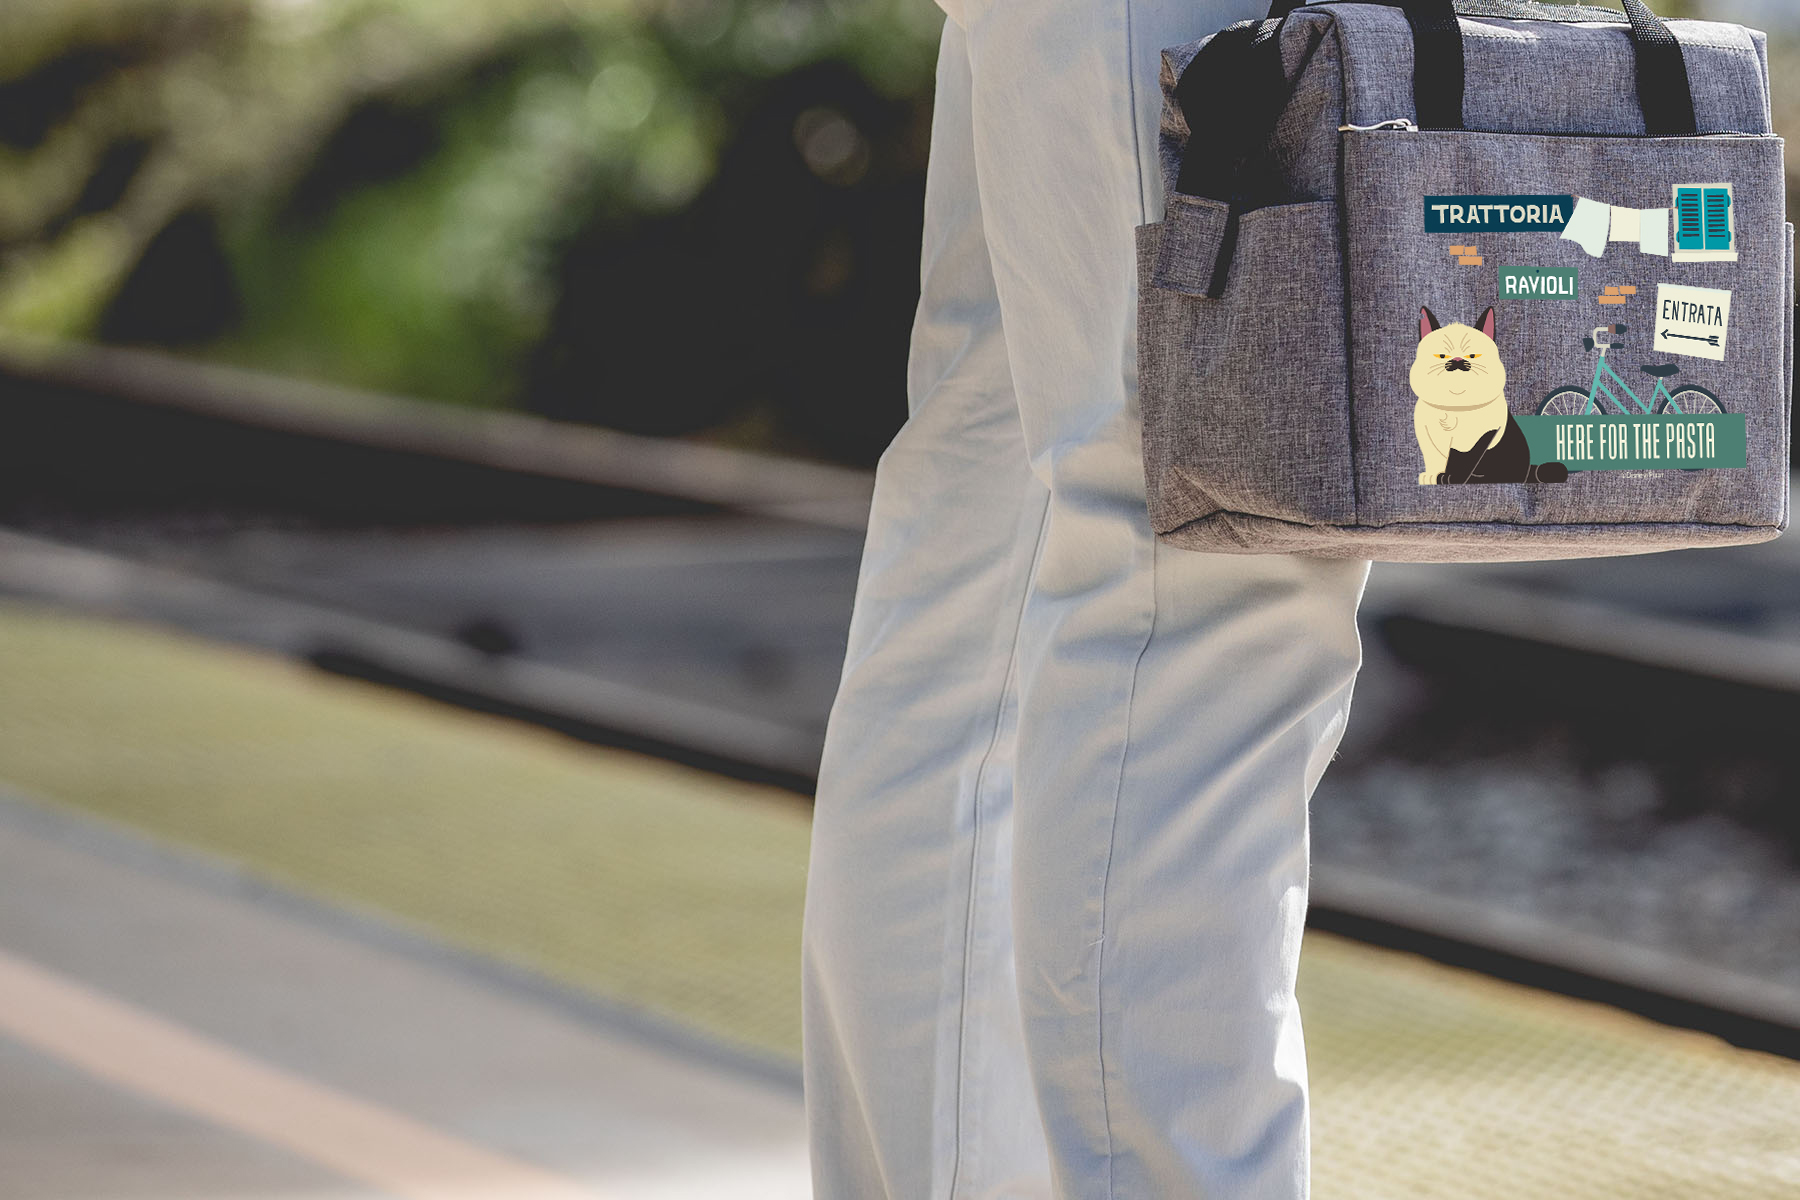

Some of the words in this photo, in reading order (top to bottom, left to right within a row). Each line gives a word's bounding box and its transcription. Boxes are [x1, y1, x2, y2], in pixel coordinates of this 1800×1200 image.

[1431, 204, 1565, 224] TRATTORIA
[1505, 275, 1574, 296] RAVIOLI
[1662, 299, 1723, 327] ENTRATA
[1556, 424, 1594, 461] HERE
[1599, 423, 1628, 460] FOR
[1633, 423, 1660, 460] THE
[1666, 422, 1715, 460] PASTA
